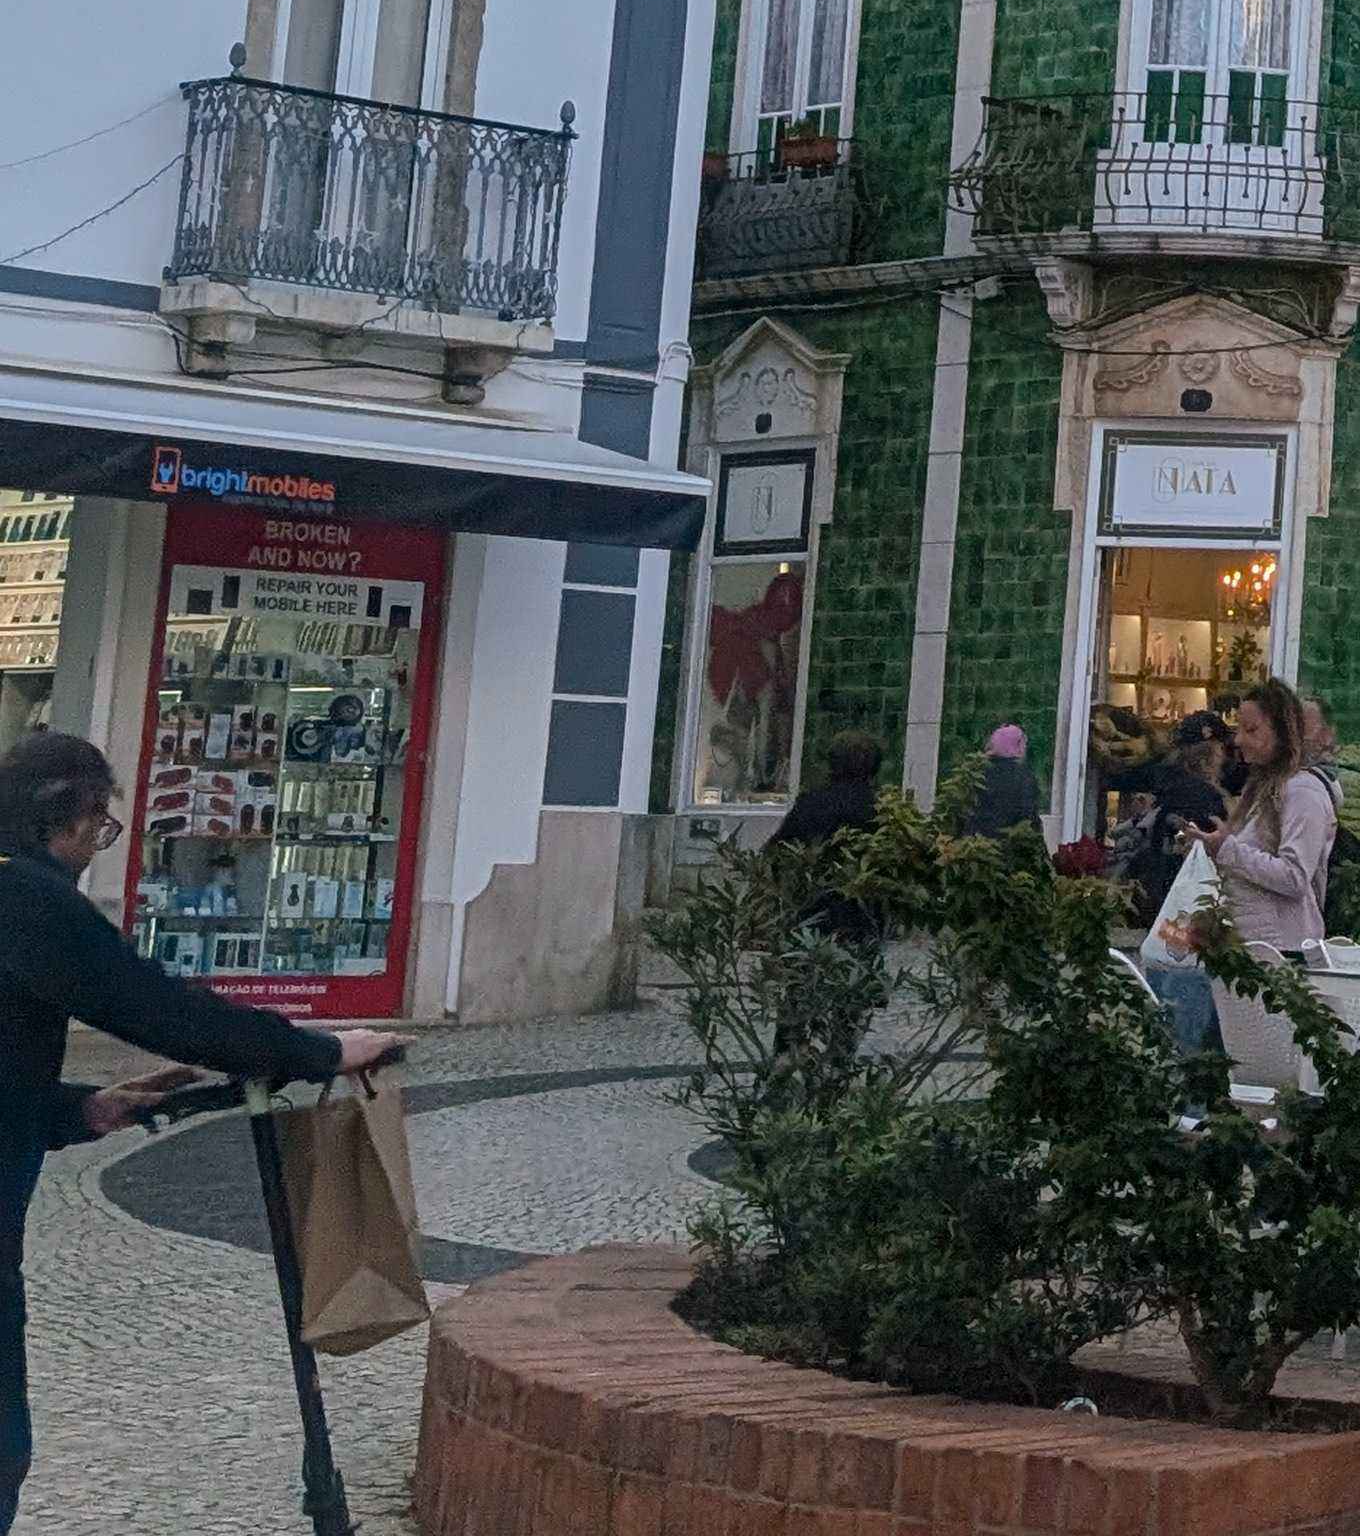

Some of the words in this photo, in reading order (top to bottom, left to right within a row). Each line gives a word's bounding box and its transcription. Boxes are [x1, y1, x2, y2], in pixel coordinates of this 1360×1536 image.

[181, 464, 335, 501] brightmobiles
[265, 519, 351, 545] BROKEN
[248, 546, 291, 568] AND
[297, 550, 361, 572] NOW?
[256, 576, 312, 595] REPAIR
[316, 581, 358, 598] YOUR
[254, 595, 312, 613] MOBILE
[316, 601, 357, 615] HERE
